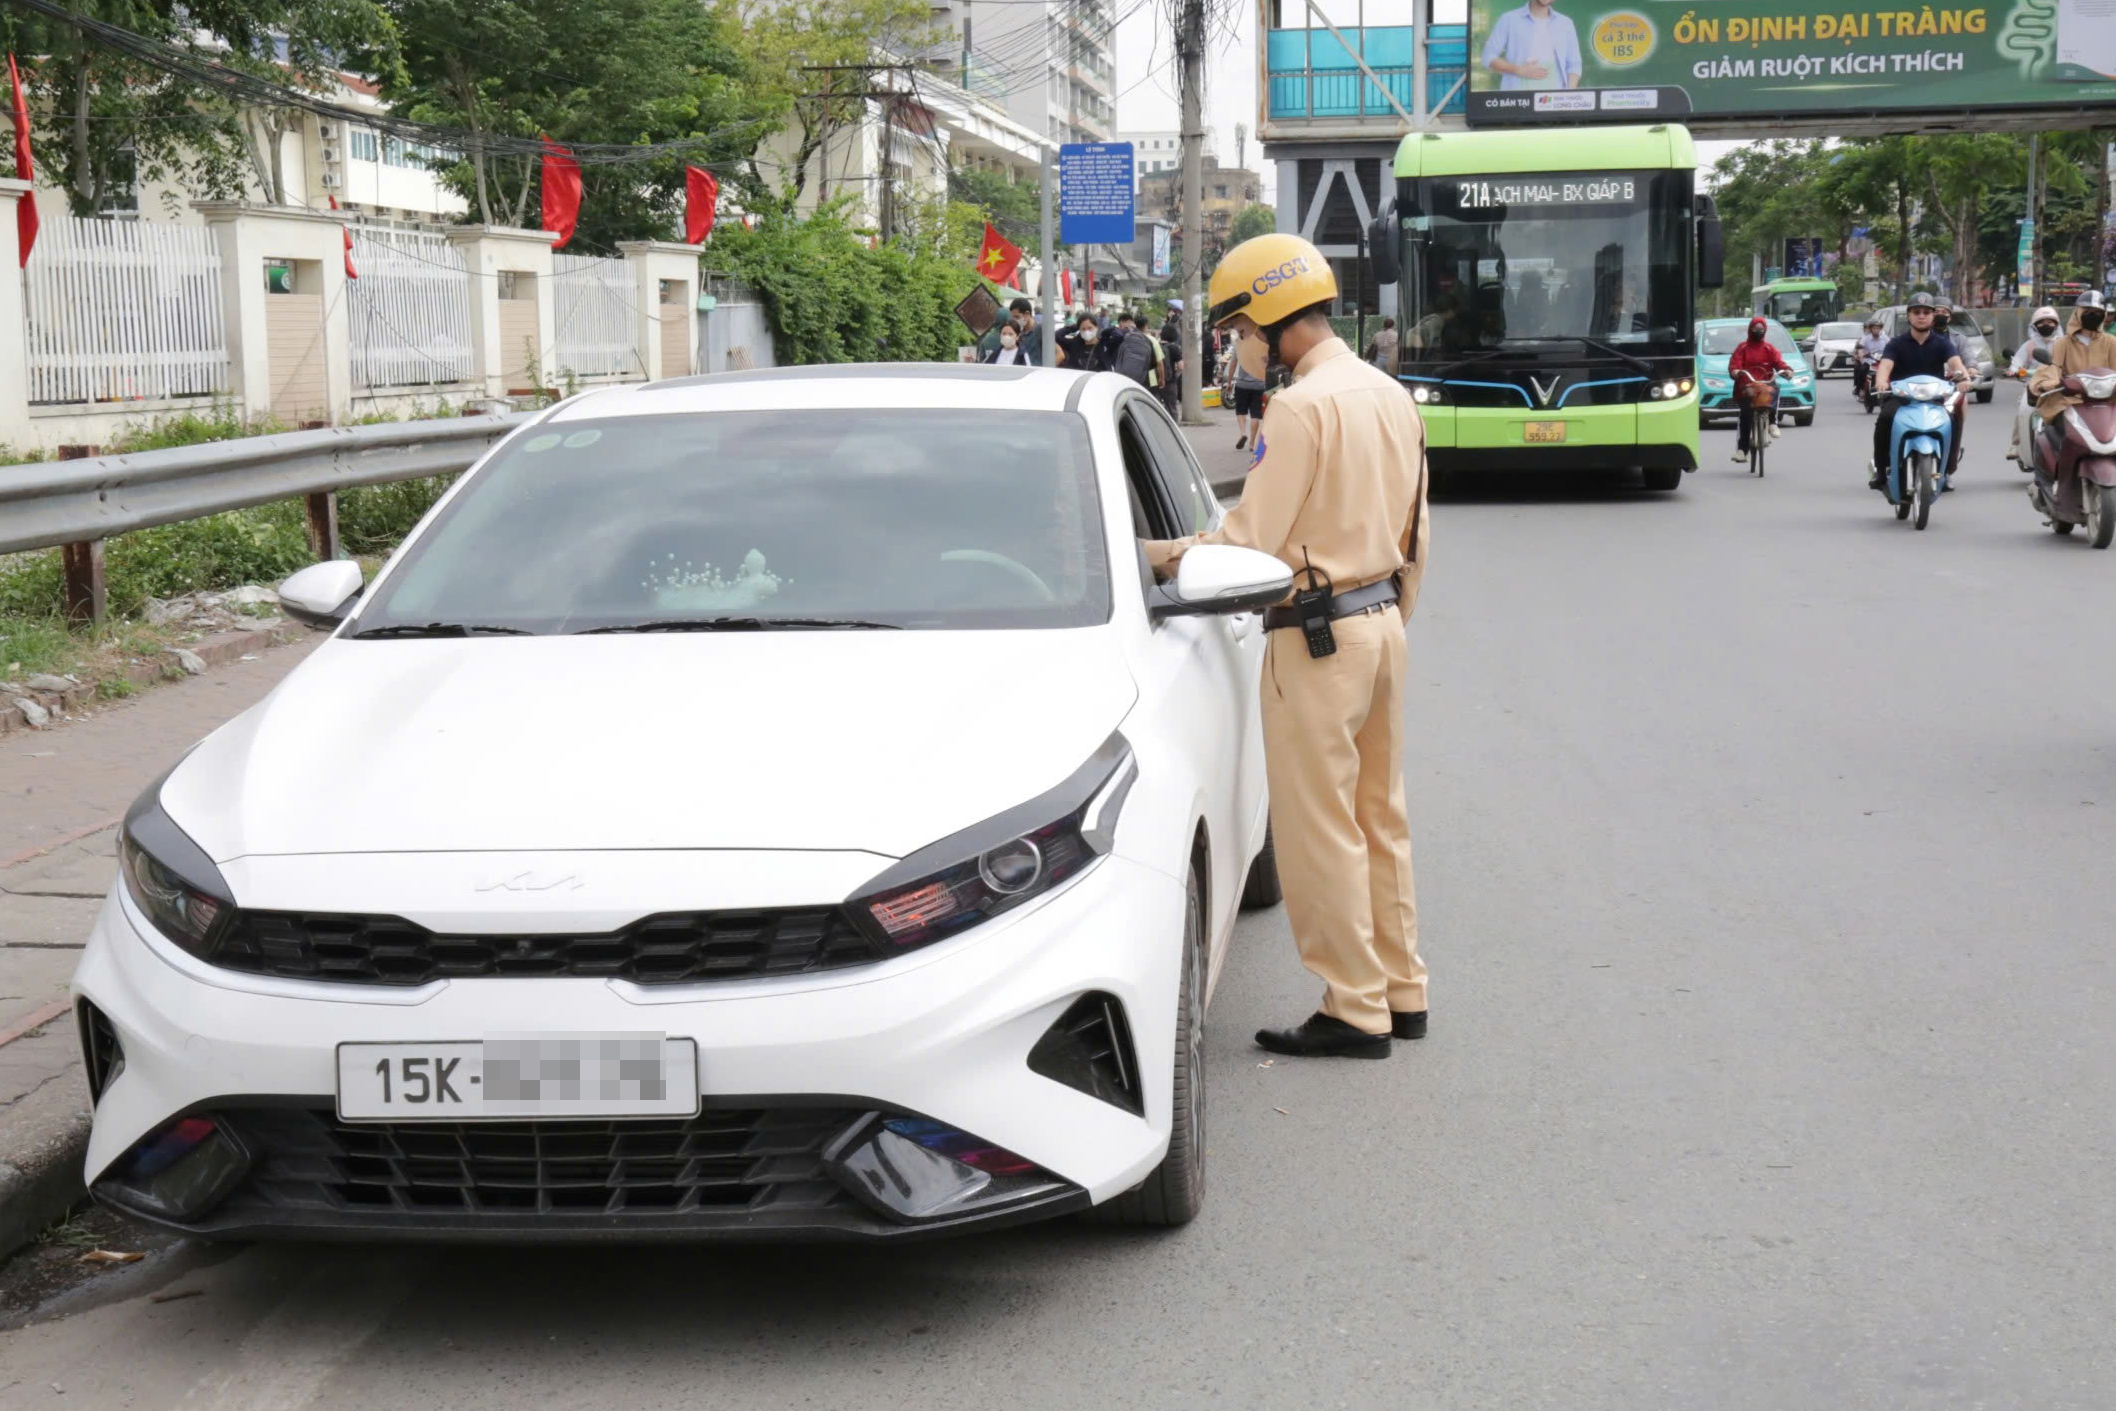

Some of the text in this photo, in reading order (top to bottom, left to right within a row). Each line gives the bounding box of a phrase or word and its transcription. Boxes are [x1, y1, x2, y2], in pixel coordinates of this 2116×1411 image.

[1617, 31, 1624, 42] 3
[1672, 5, 1987, 48] ỔN ĐỊNH ĐẠI TRÀNG
[1613, 45, 1633, 57] IBS
[1693, 49, 1964, 80] GIẢM RUỘT KÍCH THÍCH
[1485, 97, 1530, 108] CÓ BÁN TẠI
[1460, 182, 1490, 208] 21A
[1563, 184, 1583, 201] BX
[1587, 178, 1620, 200] GIÁP
[1252, 256, 1309, 295] CSGT
